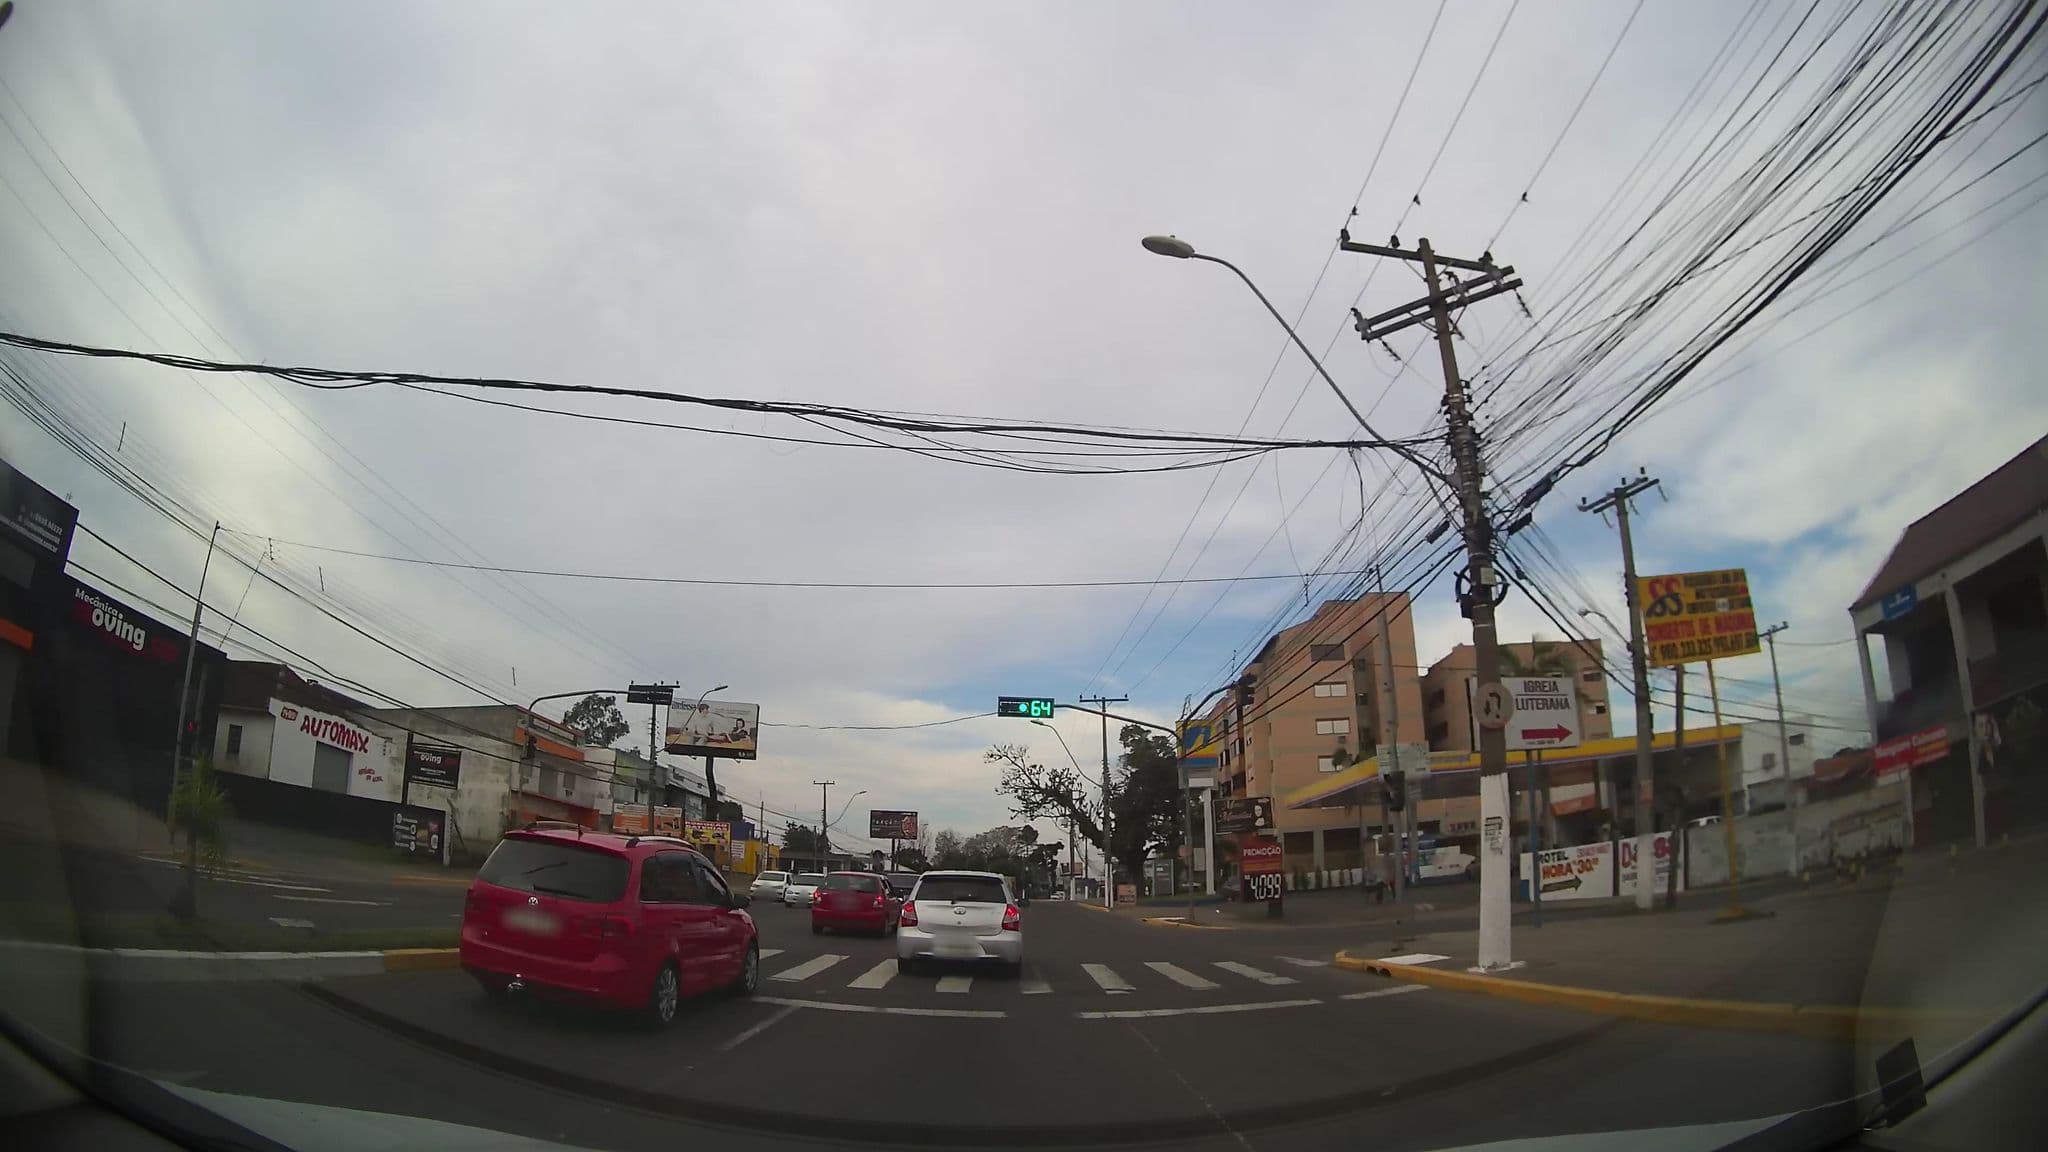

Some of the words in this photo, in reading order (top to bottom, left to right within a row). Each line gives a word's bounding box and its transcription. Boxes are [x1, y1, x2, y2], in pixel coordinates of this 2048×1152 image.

[1030, 700, 1051, 716] 64
[1515, 697, 1571, 711] LUTERANA
[300, 715, 370, 754] AUTOMAX
[1243, 845, 1281, 857] PROMOÇÃO
